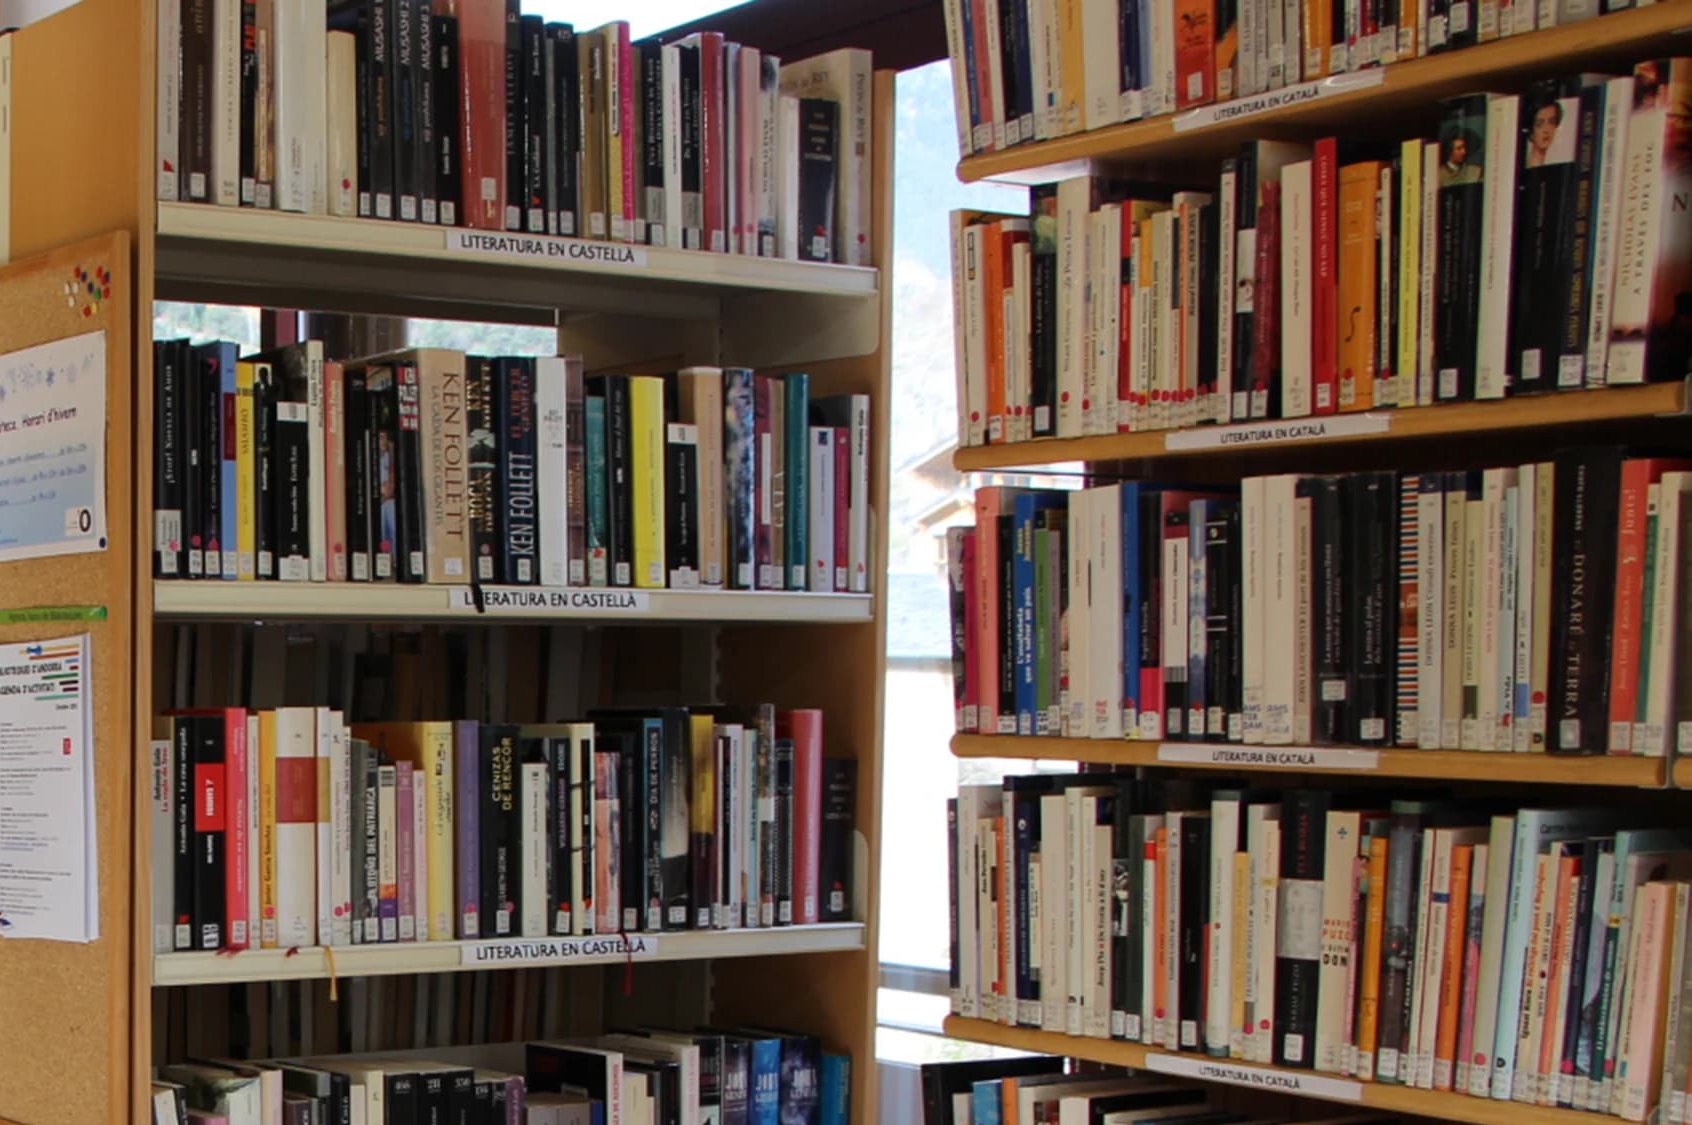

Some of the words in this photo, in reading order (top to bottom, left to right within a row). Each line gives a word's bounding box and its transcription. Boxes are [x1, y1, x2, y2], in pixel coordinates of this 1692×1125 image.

[375, 8, 385, 62] MUSASHI
[399, 11, 410, 65] MUSASHI
[420, 14, 430, 70] MUSASHI
[1214, 98, 1266, 121] LITERATURA
[1268, 95, 1281, 108] EN
[1282, 86, 1319, 105] CATALÀ
[461, 234, 544, 257] LITERATURA
[548, 242, 565, 257] EN
[569, 243, 636, 263] CASTELLÀ
[443, 372, 461, 425] KEN
[466, 380, 479, 410] KEN
[432, 438, 442, 452] DE
[1220, 428, 1273, 445] LITERATURA
[1275, 427, 1287, 440] EN
[1289, 423, 1325, 439] CATALÀ
[433, 455, 443, 473] LOS
[433, 475, 444, 527] GIGANTES
[444, 433, 464, 542] FOLLETT
[469, 480, 484, 518] BOCA
[509, 450, 533, 518] FOLLETT
[1622, 488, 1637, 535] Junts!
[510, 522, 535, 556] KEN
[551, 592, 567, 607] EN
[571, 590, 636, 609] CASTELLÀ
[1449, 583, 1457, 609] LEON
[1569, 554, 1587, 634] DONARÉ
[1448, 611, 1457, 649] DONNA
[1563, 654, 1579, 717] TERRA
[501, 736, 512, 790] RENCOR
[649, 731, 658, 769] PERROS
[1212, 750, 1266, 764] LITERATURA
[1268, 752, 1280, 764] EN
[1281, 750, 1315, 766] CATALÀ
[491, 746, 502, 801] CENIZAS
[365, 786, 376, 836] PATRIARCA
[502, 793, 512, 810] DE
[476, 944, 557, 962] LITERATURA
[562, 943, 579, 957] EN
[1323, 954, 1348, 967] DON
[1199, 1066, 1250, 1082] LITERATURA
[1252, 1071, 1263, 1084] EN
[1265, 1071, 1300, 1088] CATALÀ
